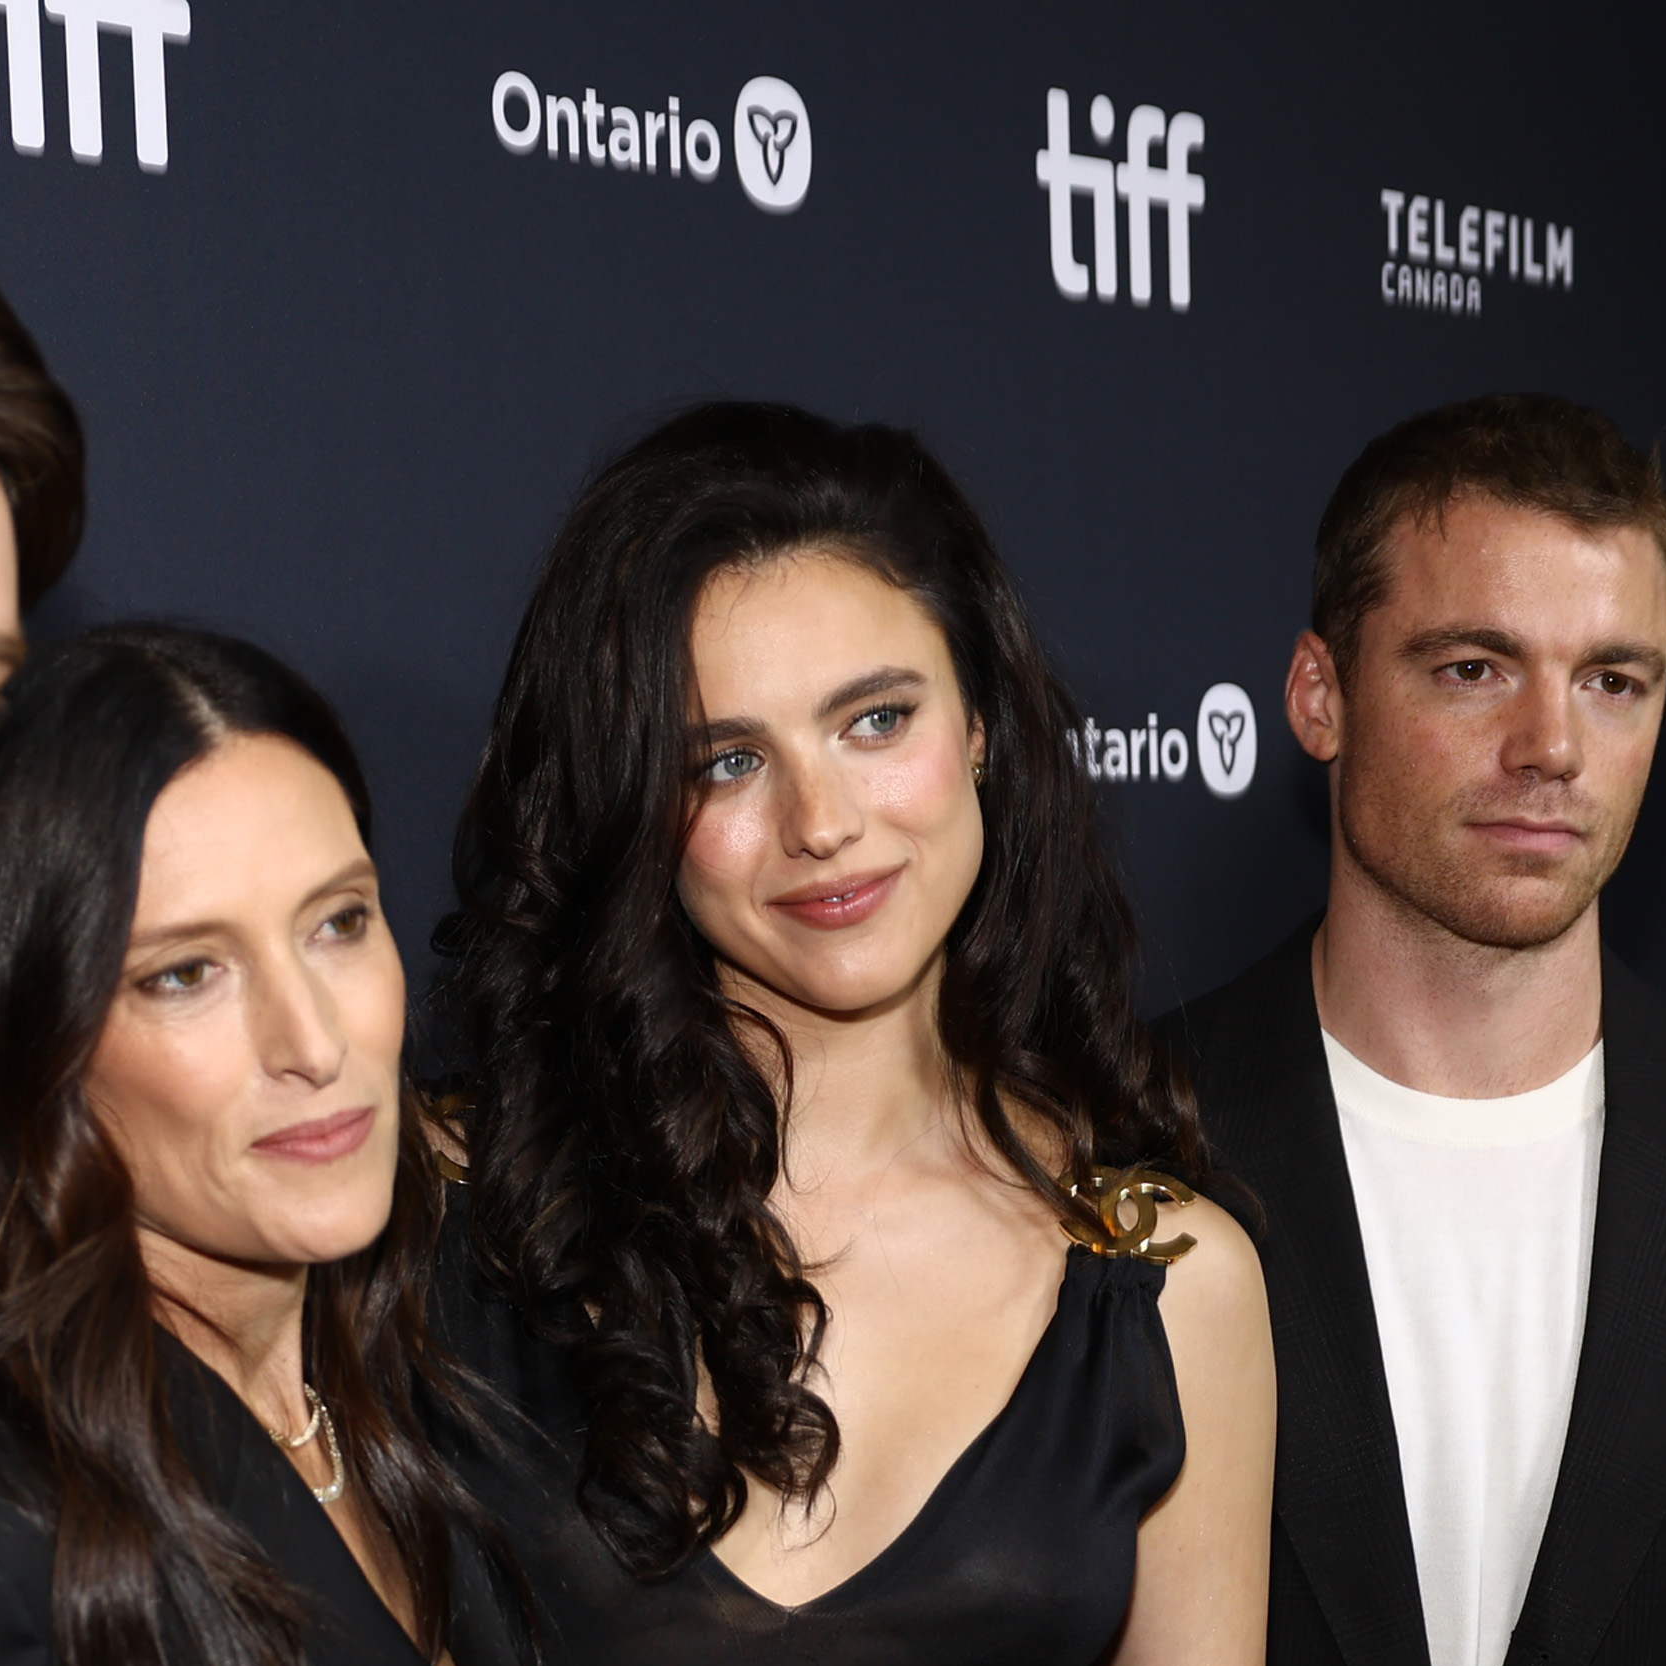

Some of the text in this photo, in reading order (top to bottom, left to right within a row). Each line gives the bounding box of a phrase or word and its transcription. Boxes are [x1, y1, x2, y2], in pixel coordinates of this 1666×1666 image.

[491, 70, 722, 184] Ontario
[1035, 86, 1206, 313] tiff
[1380, 187, 1574, 292] TELEFILM
[1381, 261, 1482, 317] CANADA
[1065, 712, 1190, 784] tario
